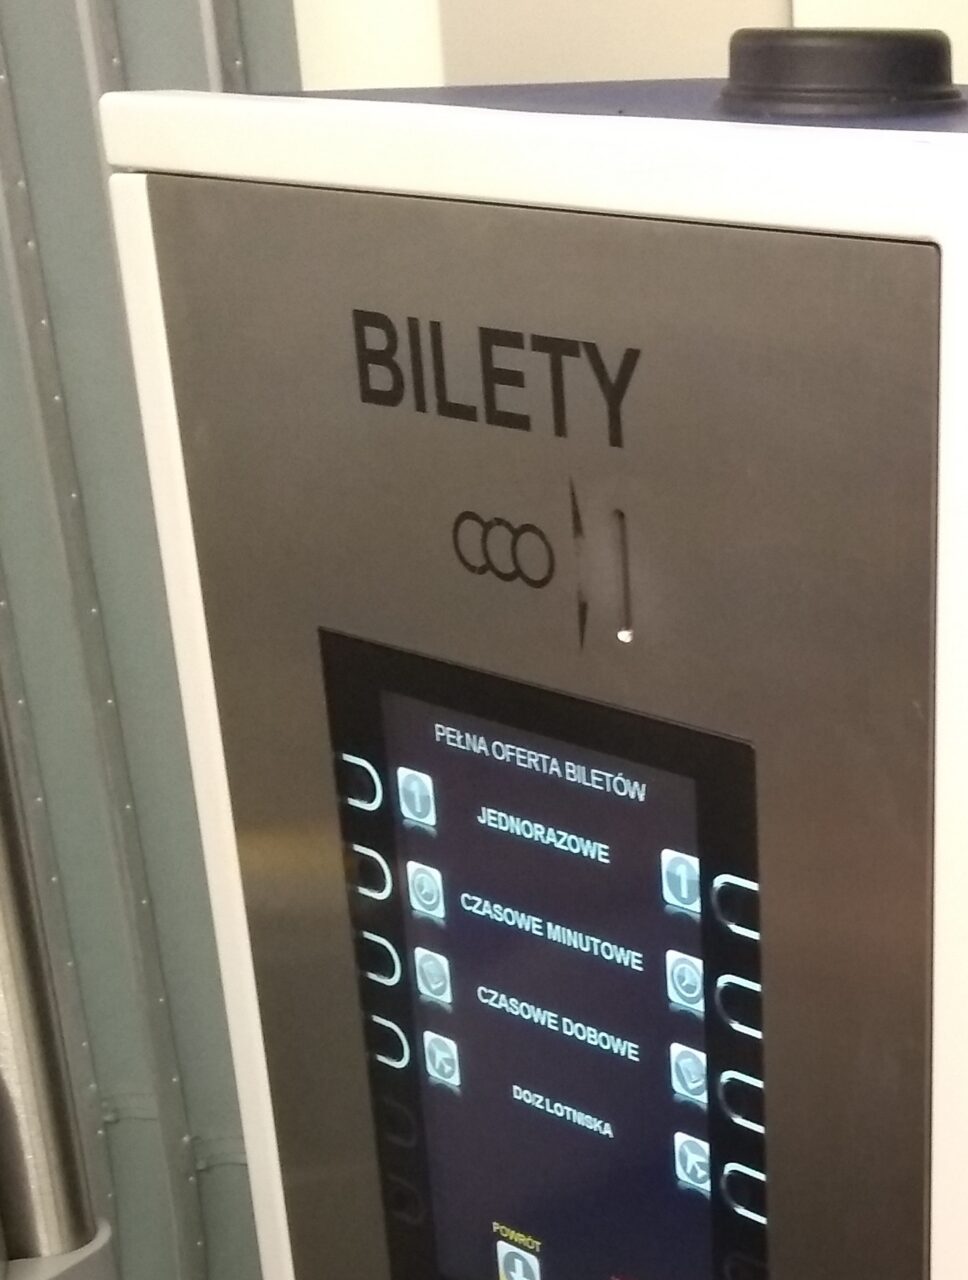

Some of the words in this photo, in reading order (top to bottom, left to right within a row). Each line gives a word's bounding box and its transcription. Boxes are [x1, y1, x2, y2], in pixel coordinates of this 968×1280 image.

[352, 308, 641, 448] BILETY
[434, 723, 489, 757] PEŁNA
[492, 741, 561, 778] OFERTA
[565, 762, 647, 802] BILETÓW
[477, 806, 611, 864] JEDNORAZOWE
[460, 893, 543, 937] CZASOWE
[546, 925, 645, 971] MINUTOWE
[476, 985, 559, 1032] CZASOWE
[562, 1016, 640, 1062] DOBOWE
[546, 1096, 613, 1138] LOTNISKA
